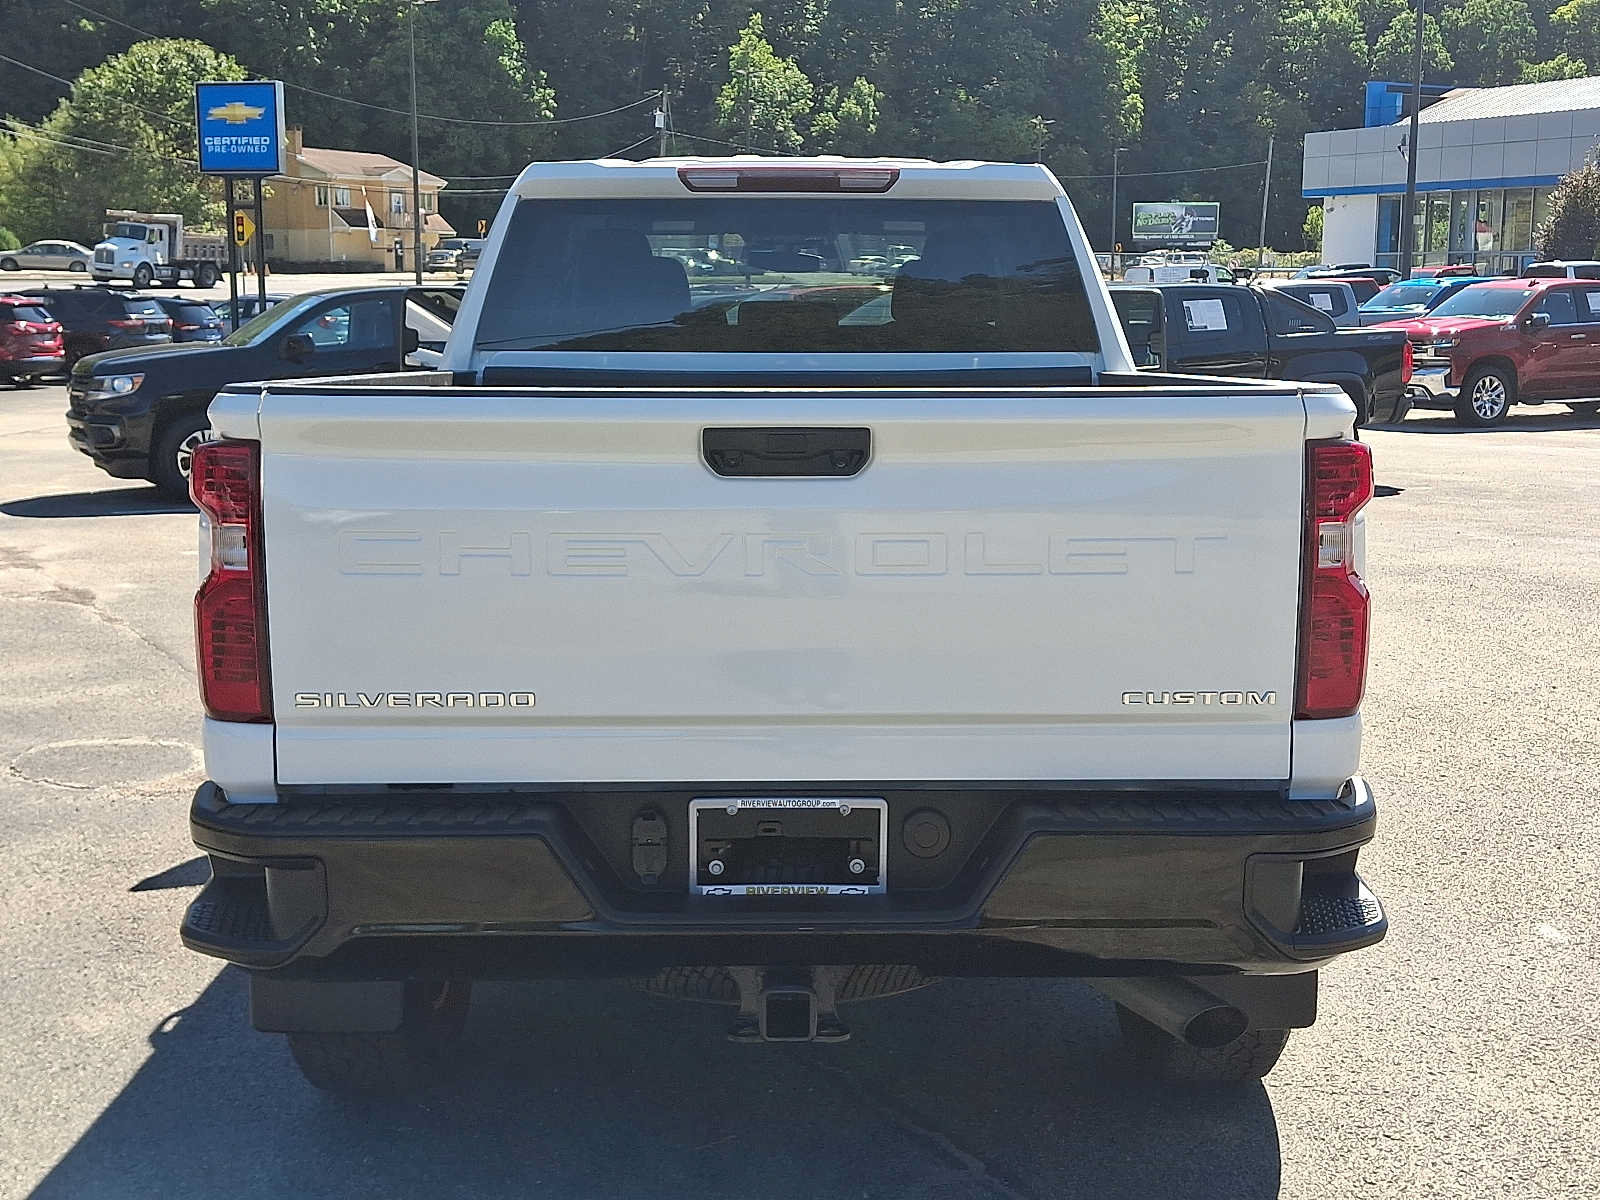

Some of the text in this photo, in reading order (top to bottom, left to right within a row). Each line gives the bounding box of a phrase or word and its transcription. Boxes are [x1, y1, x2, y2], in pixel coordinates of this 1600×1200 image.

[204, 136, 270, 145] CERTIFIED
[207, 144, 268, 153] PRE-OWNED
[338, 531, 1228, 577] CHEVROLET
[294, 691, 537, 708] SILVERADO
[1121, 690, 1278, 705] CUSTOM
[740, 799, 837, 808] RIVERVIEWAUTOGROUP.com
[745, 886, 830, 896] RIVERVIEW
